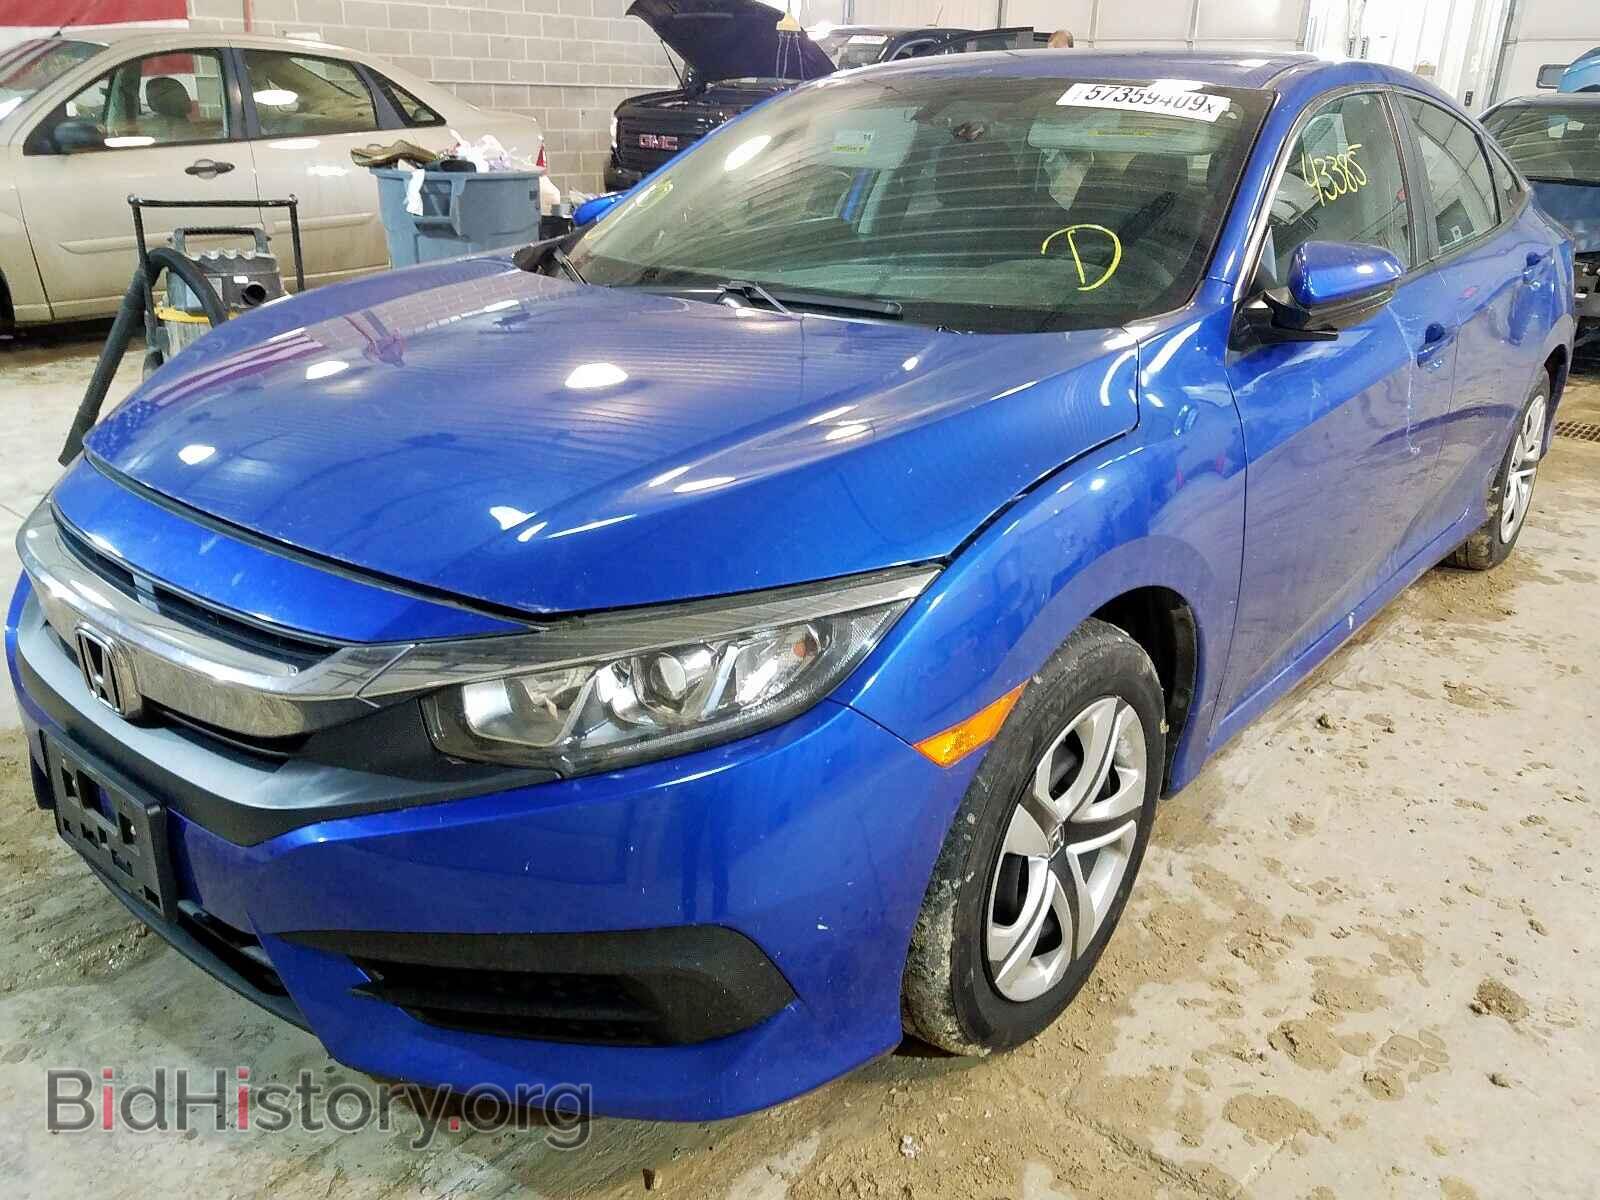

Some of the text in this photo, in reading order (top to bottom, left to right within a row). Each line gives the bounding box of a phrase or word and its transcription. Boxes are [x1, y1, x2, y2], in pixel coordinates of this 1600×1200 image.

[639, 134, 678, 151] GMC
[1301, 144, 1368, 208] 43385
[1040, 224, 1122, 291] D
